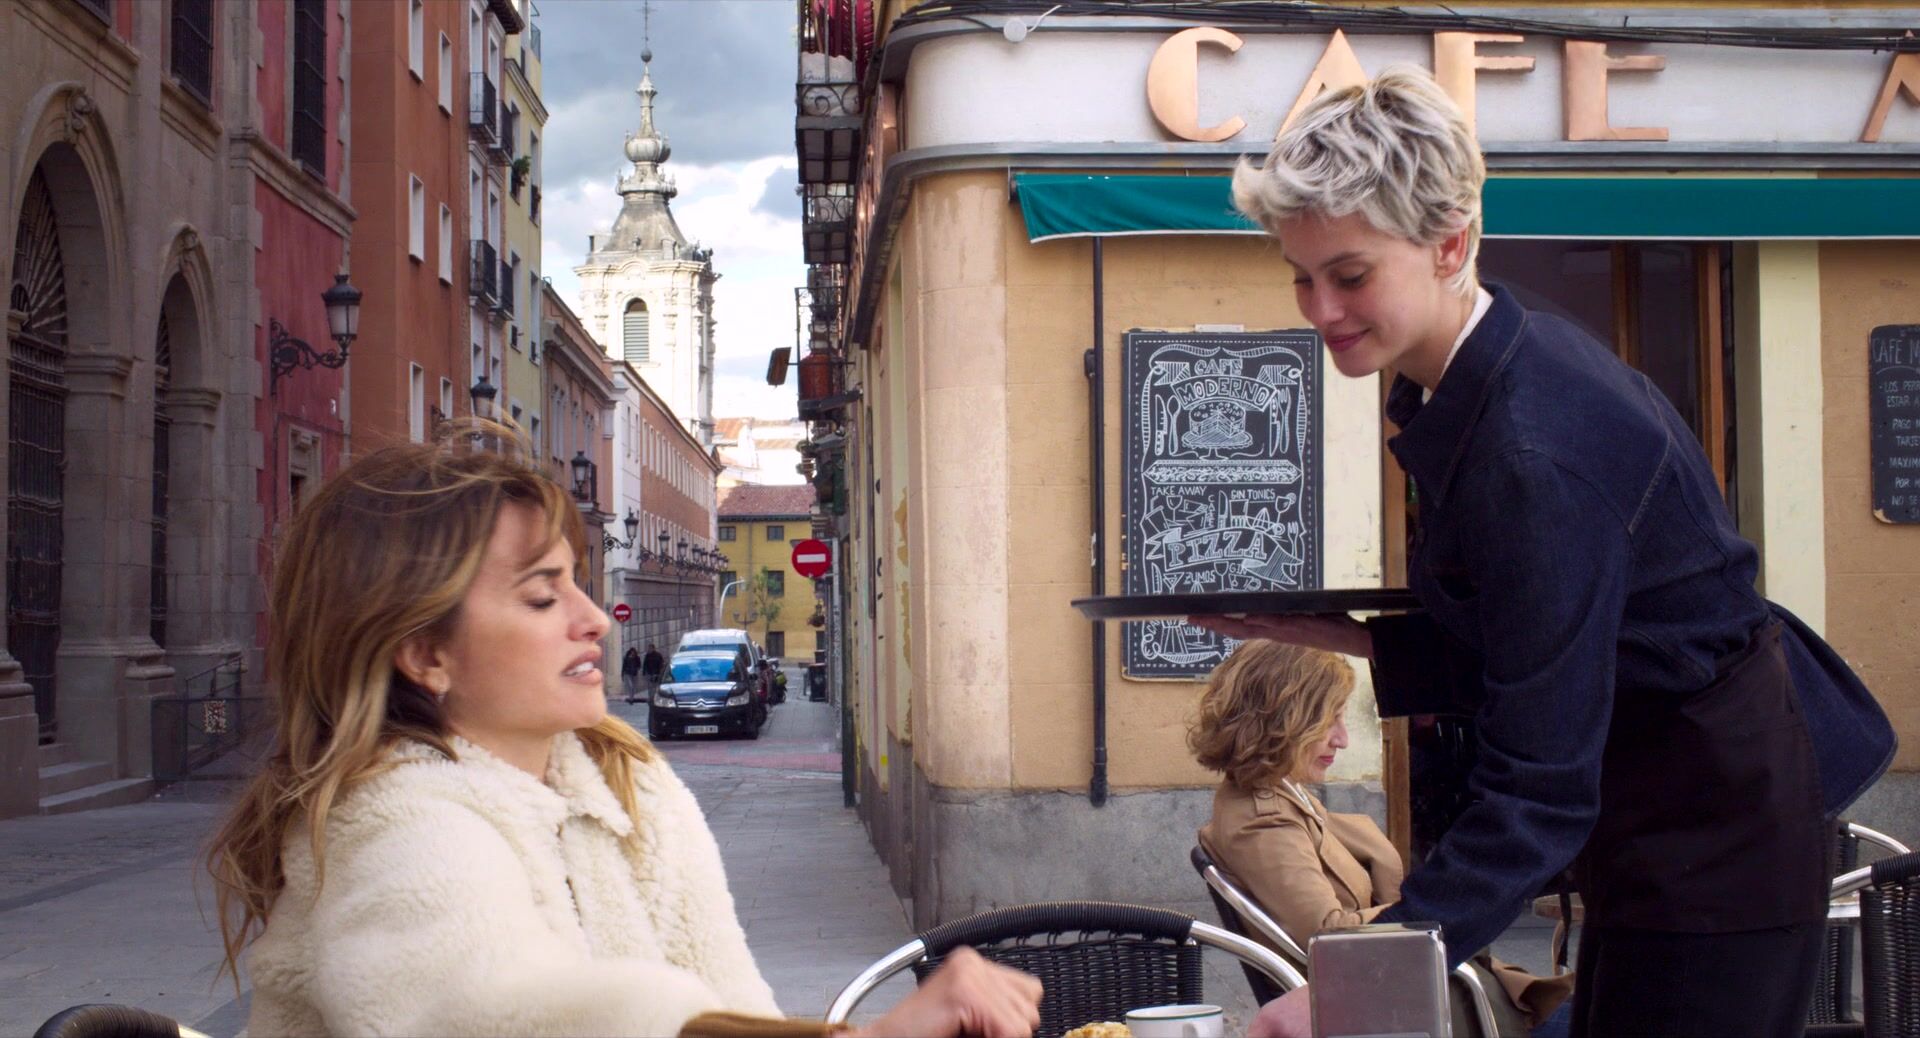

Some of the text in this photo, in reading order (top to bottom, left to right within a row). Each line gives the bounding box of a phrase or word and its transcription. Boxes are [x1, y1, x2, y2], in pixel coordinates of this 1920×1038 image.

[1175, 378, 1270, 406] MODERNO
[1151, 486, 1207, 496] TAKE AWAY
[1231, 488, 1276, 501] GIN TONICS
[1169, 531, 1267, 567] PIZZA
